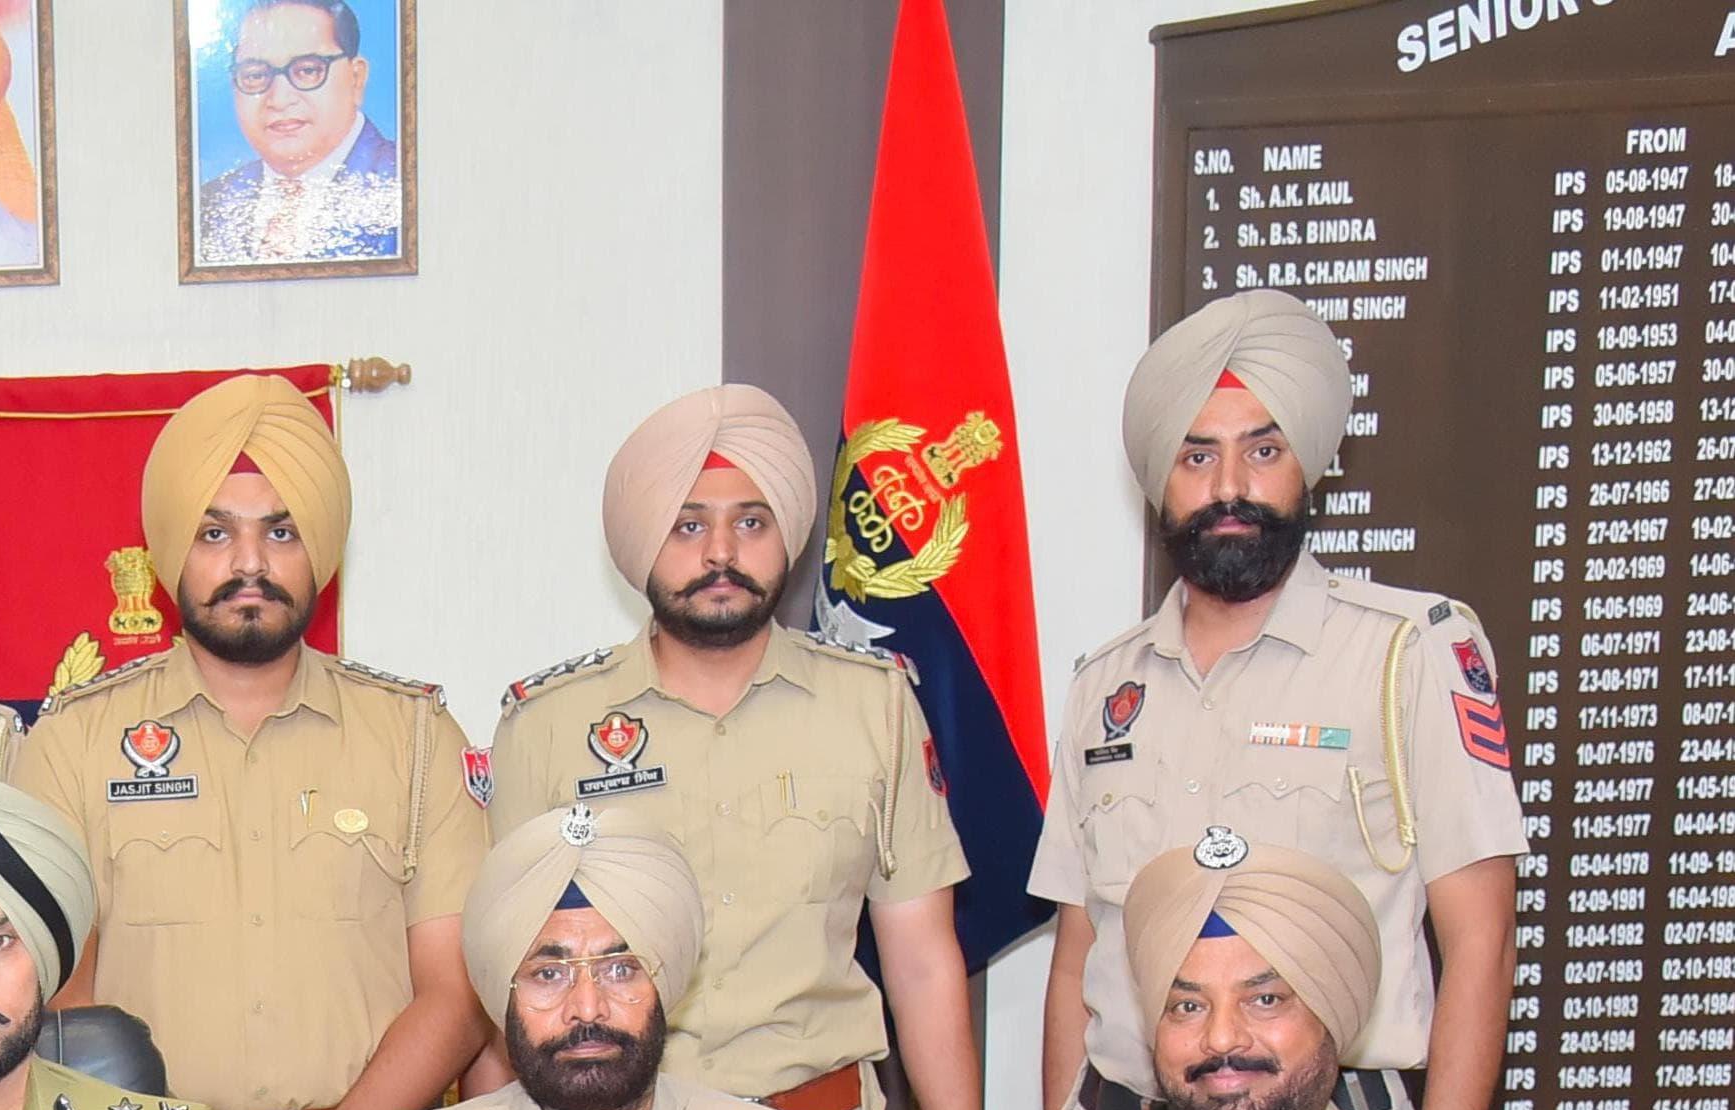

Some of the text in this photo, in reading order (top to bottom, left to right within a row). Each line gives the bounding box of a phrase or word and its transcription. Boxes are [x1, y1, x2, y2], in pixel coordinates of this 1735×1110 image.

[1194, 127, 1687, 175] S.NO. NAME FROM
[1205, 187, 1220, 212] 1.
[1239, 186, 1265, 210] Sh.
[1268, 183, 1303, 209] A.K.
[1307, 181, 1353, 206] KAUL
[1555, 171, 1585, 195] IPS
[1605, 166, 1688, 193] 05-08-1947
[1203, 226, 1220, 249] 2.
[1269, 221, 1302, 246] B.S.
[1306, 218, 1376, 244] BINDRA
[1553, 209, 1583, 232] IPS
[1604, 204, 1685, 231] 19-08-1947
[1202, 266, 1218, 290] 3.
[1268, 262, 1301, 287] R.B.
[1374, 256, 1428, 282] SINGH
[1551, 250, 1581, 274] IPS
[1601, 245, 1683, 272] 01-10-1947
[1352, 296, 1406, 321] SINGH
[1549, 289, 1579, 313] IPS
[1599, 284, 1679, 310] 11-02-1951
[1547, 329, 1576, 352] IPS
[1597, 323, 1677, 349] 18-09-1953
[1544, 366, 1574, 389] IPS
[1595, 360, 1676, 387] 05-06-1957
[1542, 404, 1572, 428] IPS
[1593, 400, 1674, 426] 30-06-1958
[1539, 446, 1569, 469] IPS
[1591, 439, 1672, 466] 13-12-1962
[1325, 491, 1371, 515] NATH
[1536, 485, 1567, 509] IPS
[1589, 480, 1670, 506] 26-07-1966
[1362, 528, 1416, 552] SINGH
[1535, 523, 1566, 547] IPS
[1587, 518, 1668, 544] 27-02-1967
[1534, 559, 1564, 583] IPS
[1585, 556, 1665, 581] 20-02-1969
[1531, 598, 1561, 621] IPS
[1583, 595, 1663, 620] 16-06-1969
[1530, 635, 1560, 658] IPS
[1581, 631, 1660, 656] 06-07-1971
[1528, 670, 1558, 694] IPS
[1579, 667, 1658, 692] 23-08-1971
[1527, 707, 1557, 730] IPS
[1578, 705, 1657, 730] 17-11-1973
[1525, 743, 1555, 766] IPS
[1577, 741, 1654, 765] 10-07-1976
[113, 781, 191, 796] JASJIT SINGH
[1522, 779, 1552, 803] IPS
[1574, 778, 1653, 803] 23-04-1977
[1522, 815, 1551, 838] IPS
[1573, 814, 1651, 839] 11-05-1977
[1517, 854, 1548, 878] IPS
[1570, 852, 1649, 877] 05-04-1978
[1516, 889, 1546, 912] IPS
[1568, 888, 1645, 912] 12-09-1981
[1516, 926, 1544, 948] IPS
[1566, 923, 1643, 948] 18-04-1982
[1514, 964, 1542, 986] IPS
[1565, 959, 1643, 984] 02-07-1983
[1510, 997, 1539, 1020] IPS
[1563, 995, 1638, 1019] 03-10-1983
[1507, 1031, 1537, 1053] IPS
[1505, 1068, 1535, 1090] IPS
